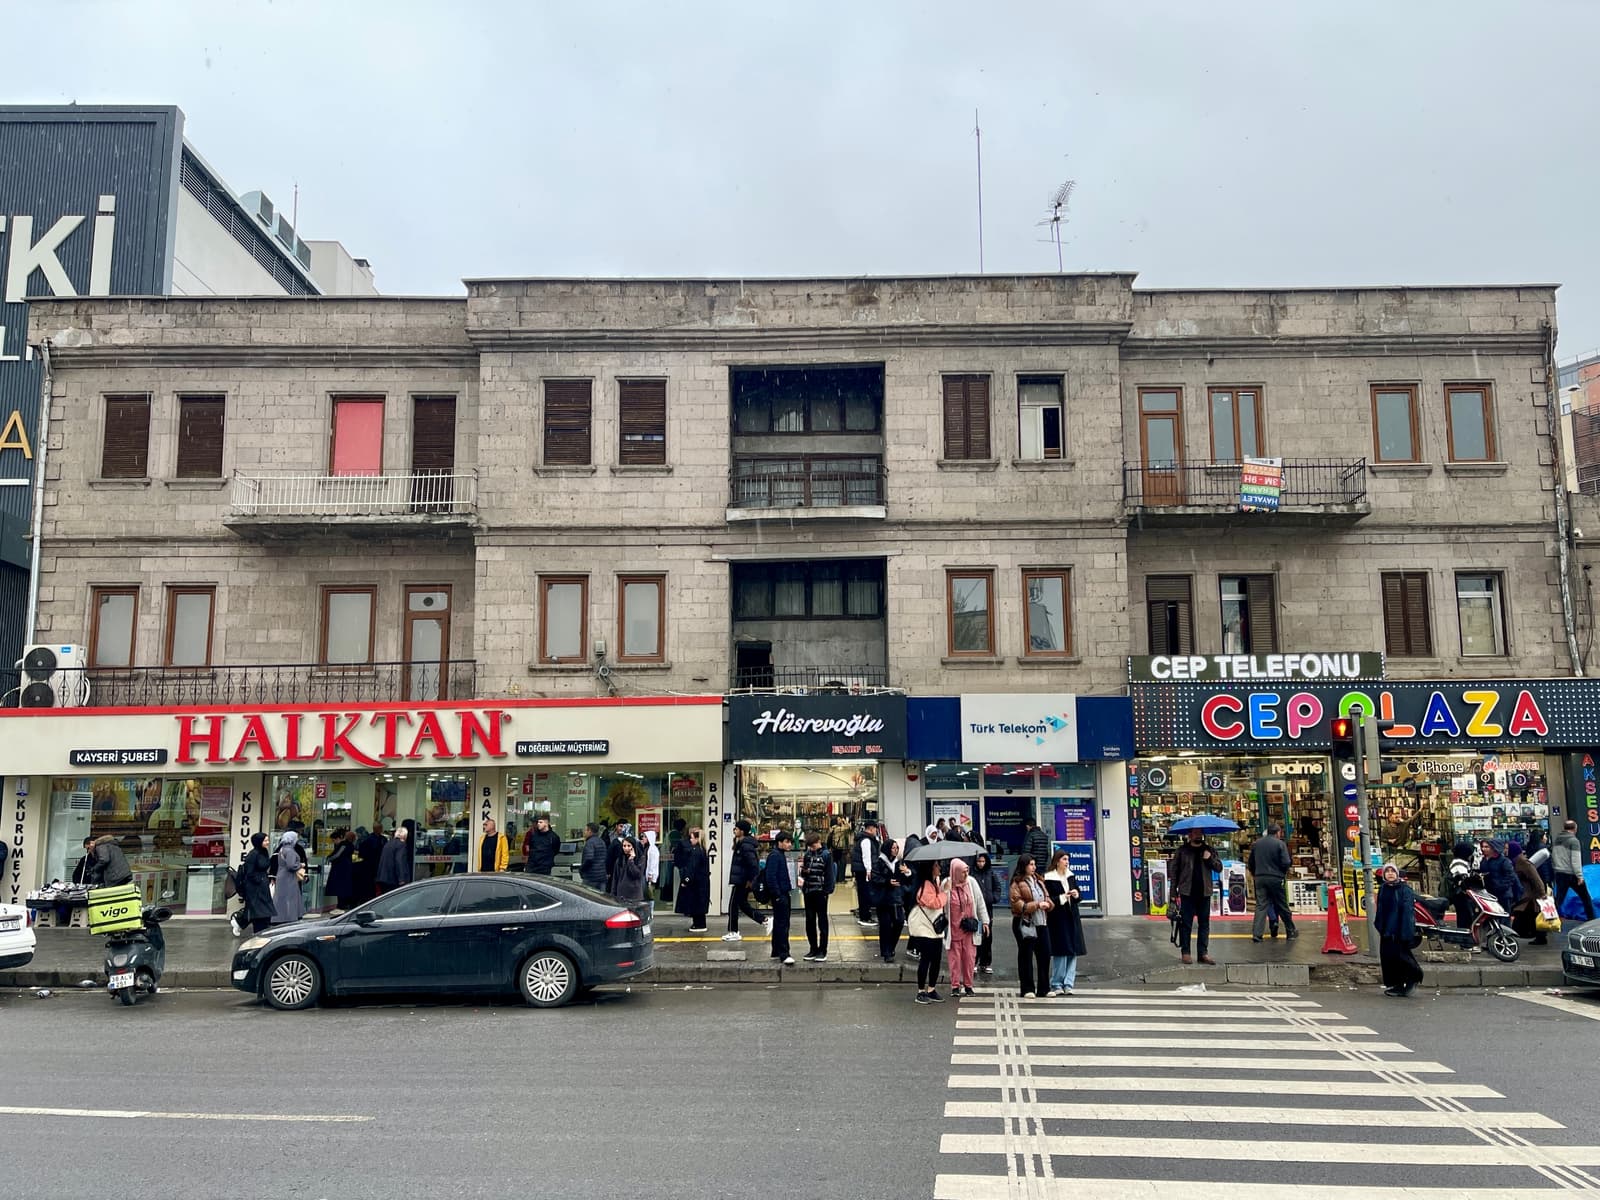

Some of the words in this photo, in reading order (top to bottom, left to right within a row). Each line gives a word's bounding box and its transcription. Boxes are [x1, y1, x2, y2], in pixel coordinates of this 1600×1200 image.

[0, 195, 116, 302] Kİ
[1151, 655, 1207, 679] CEP
[1214, 653, 1361, 678] TELEFONU
[752, 708, 885, 737] Hüsrevoğlu
[970, 723, 995, 734] Türk
[998, 723, 1047, 734] Telekom
[1201, 692, 1324, 740] CEP
[174, 710, 508, 768] HALKTAN
[517, 744, 527, 753] EN
[528, 742, 566, 753] DEĞERLİMİZ
[567, 740, 607, 754] MÜŞTERİMİZ
[76, 750, 118, 762] KAYSERİ
[121, 750, 158, 764] ŞUBESİ
[1271, 760, 1323, 775] realme
[1422, 760, 1464, 773] iPhone
[318, 788, 325, 797] 2
[482, 787, 491, 820] BAK
[1582, 753, 1600, 865] AKSESUAR
[240, 791, 251, 862] KURUYE
[708, 782, 718, 864] BAHARAT
[100, 906, 128, 917] vigo
